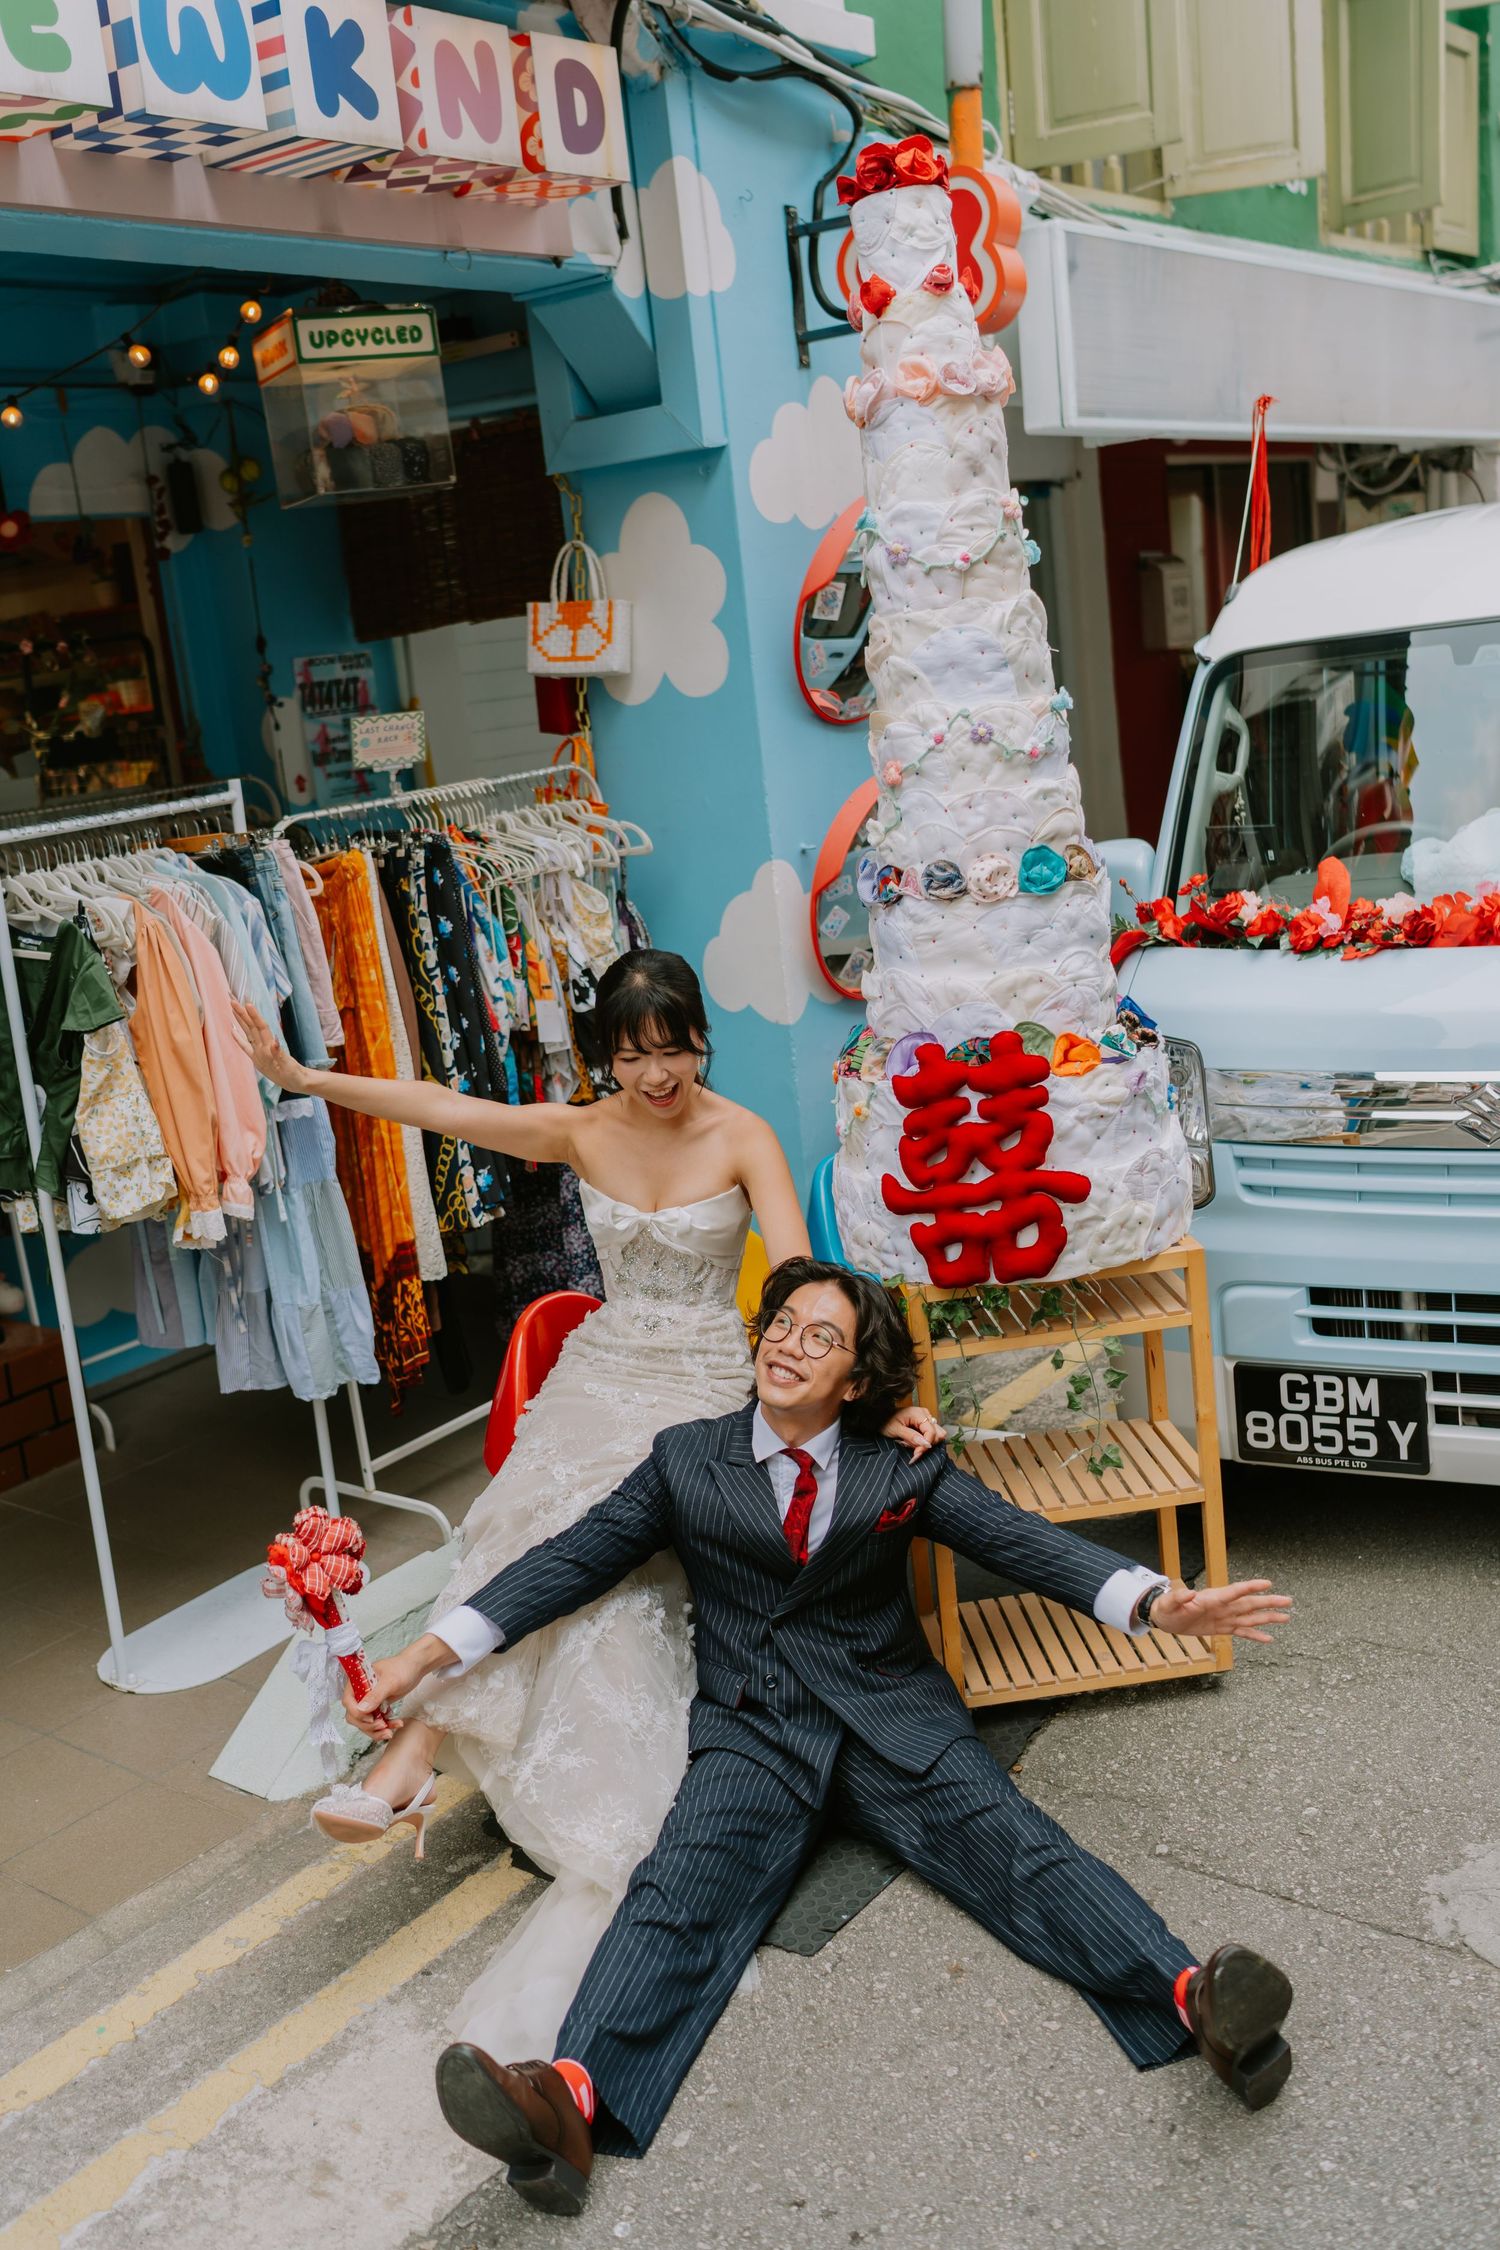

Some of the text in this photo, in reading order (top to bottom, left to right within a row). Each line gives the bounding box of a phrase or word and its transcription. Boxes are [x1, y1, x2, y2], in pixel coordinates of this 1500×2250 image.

[308, 324, 424, 350] UPCYCLED
[359, 722, 416, 735] LAST CHANCE
[377, 734, 399, 744] RACK
[1279, 1372, 1381, 1418] GBM
[1245, 1410, 1418, 1461] 8055 Y
[1296, 1456, 1368, 1469] ABS BUS PTE LTD
